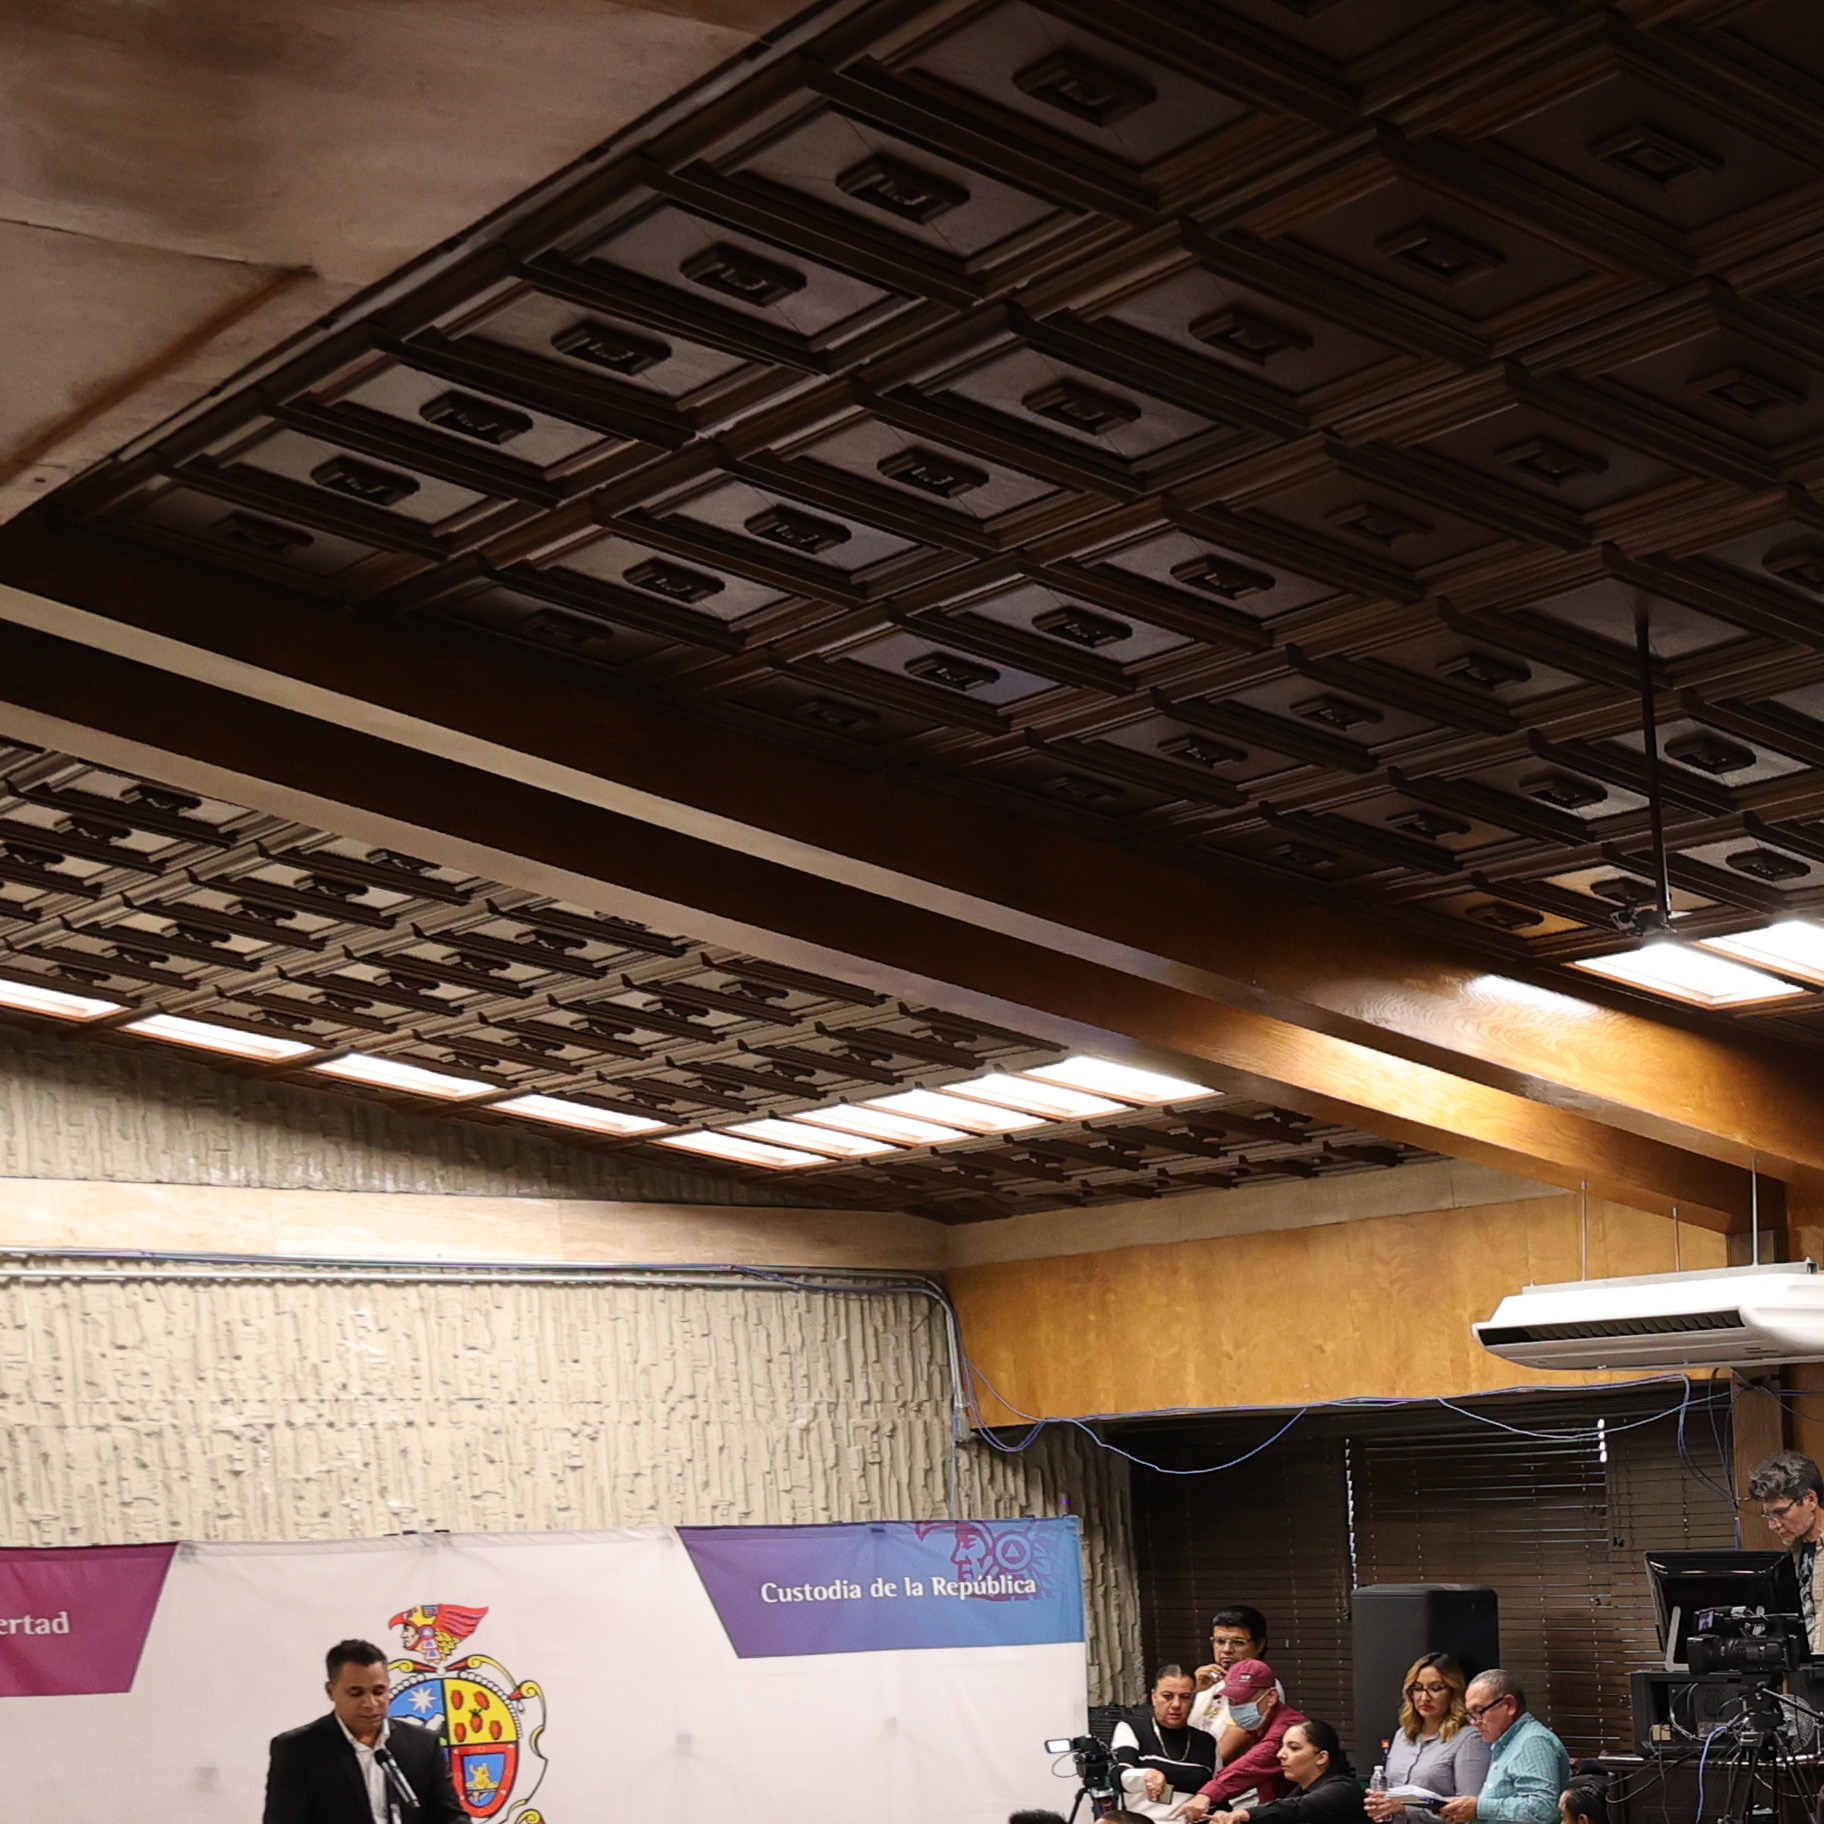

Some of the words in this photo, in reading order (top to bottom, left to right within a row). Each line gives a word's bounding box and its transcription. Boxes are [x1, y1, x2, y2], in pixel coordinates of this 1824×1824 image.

[761, 1579, 862, 1603] Custodia
[870, 1577, 897, 1598] de
[904, 1577, 924, 1597] la
[931, 1575, 1037, 1600] República
